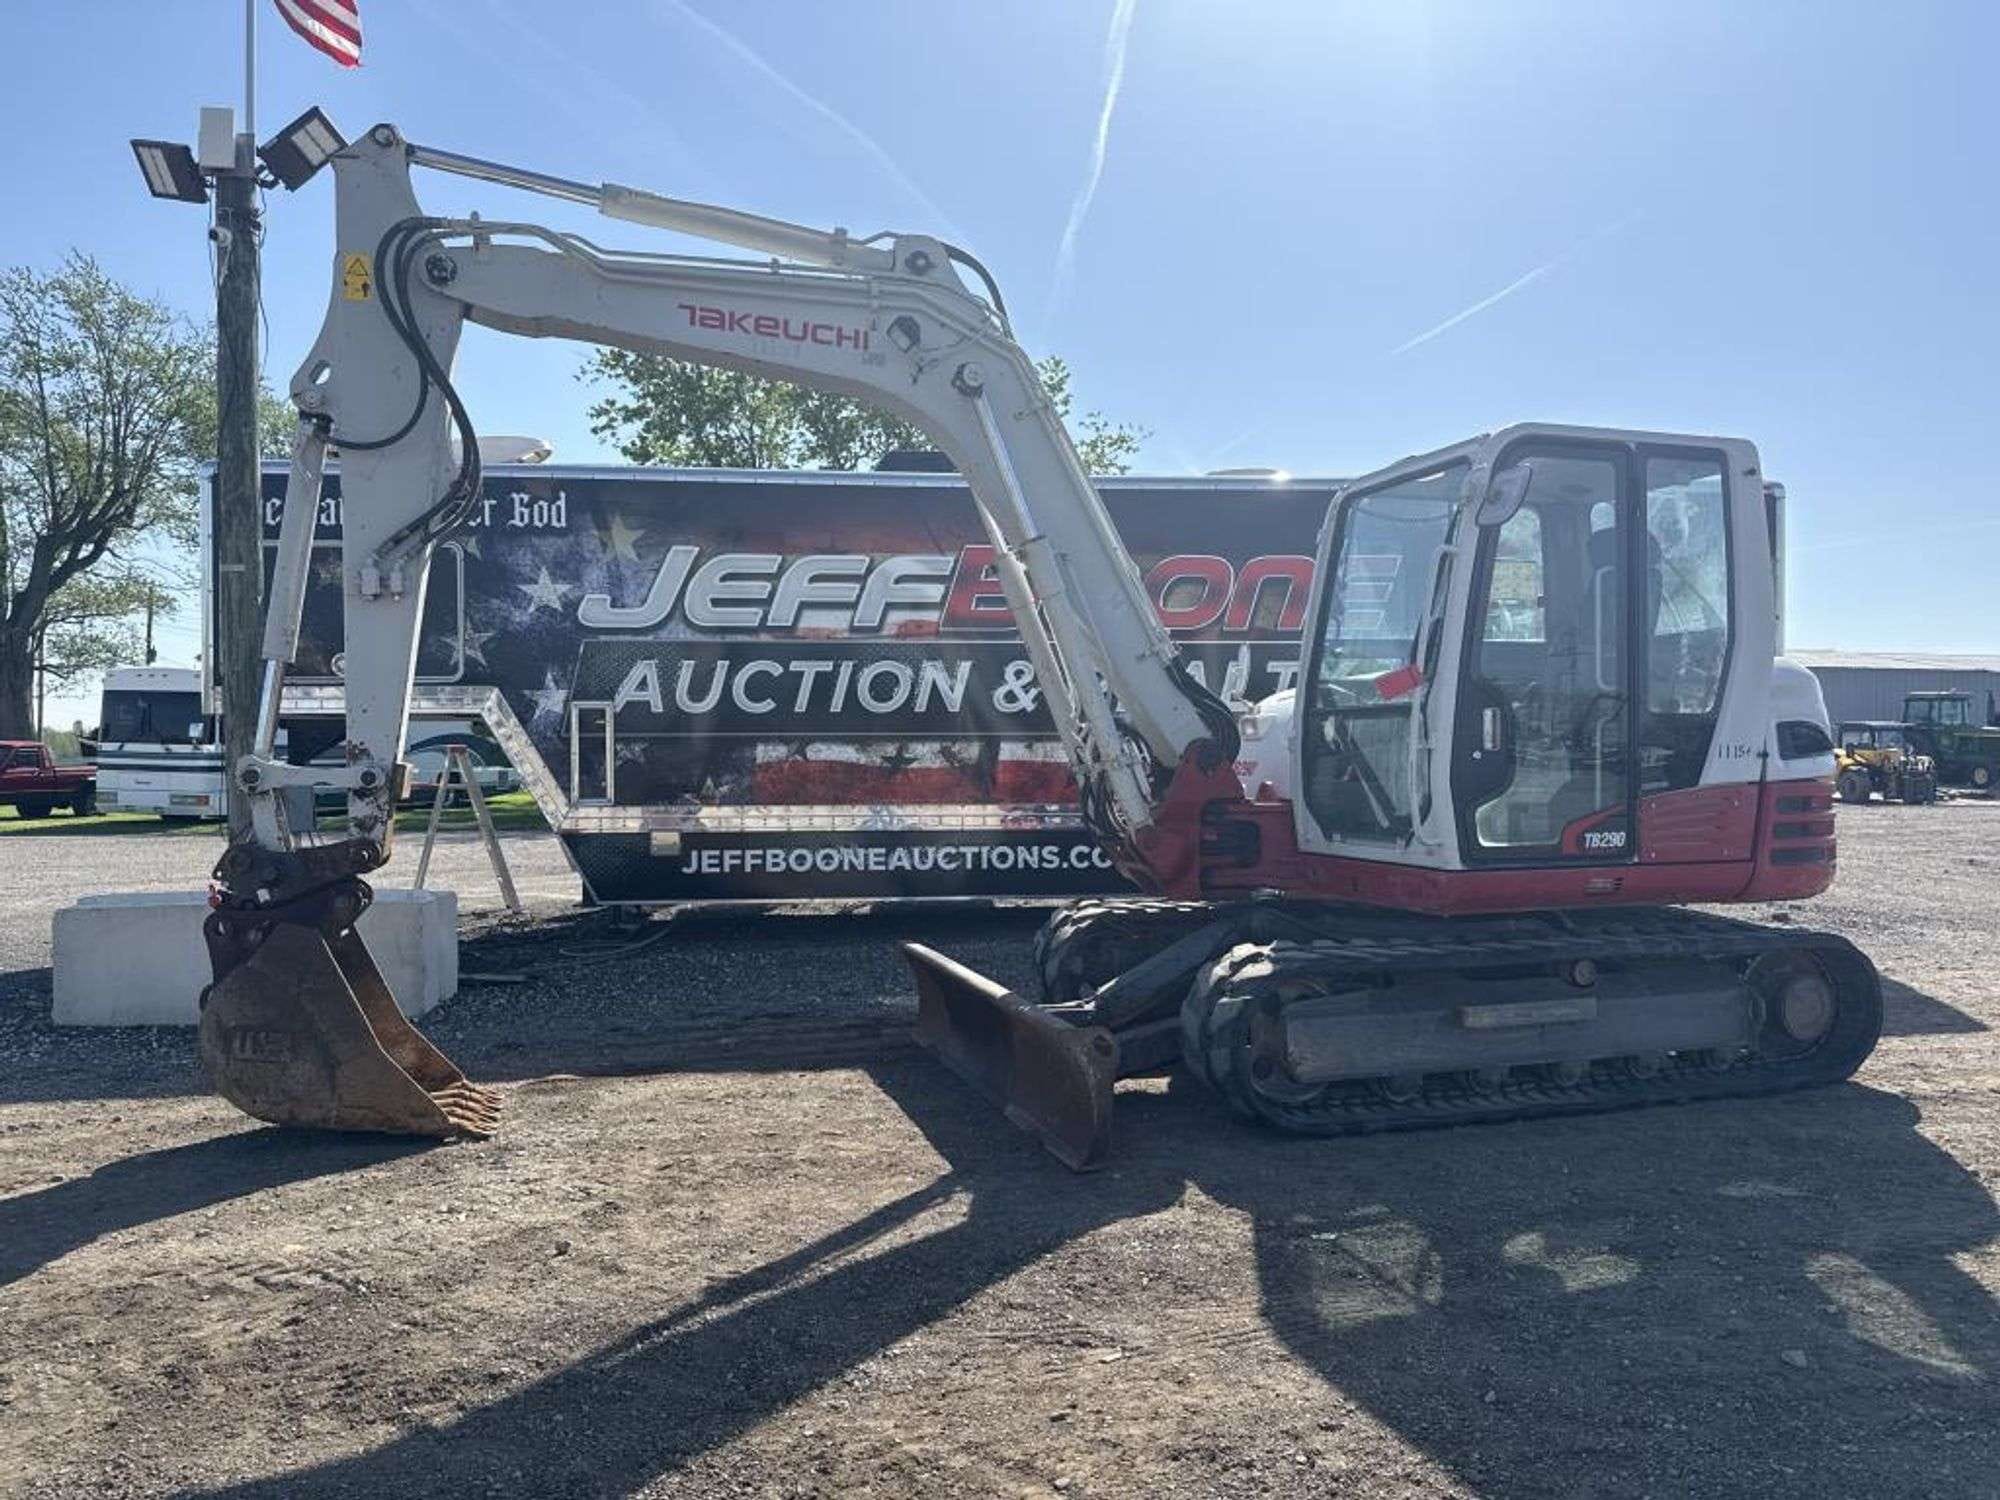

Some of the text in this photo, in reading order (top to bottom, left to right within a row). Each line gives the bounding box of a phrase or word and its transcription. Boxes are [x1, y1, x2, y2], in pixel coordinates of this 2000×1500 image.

[613, 659, 973, 714] AUCTION
[993, 660, 1042, 713] &
[1584, 831, 1627, 849] TB290
[681, 844, 1113, 875] JEFFBOONEAUCTIONS.CO
